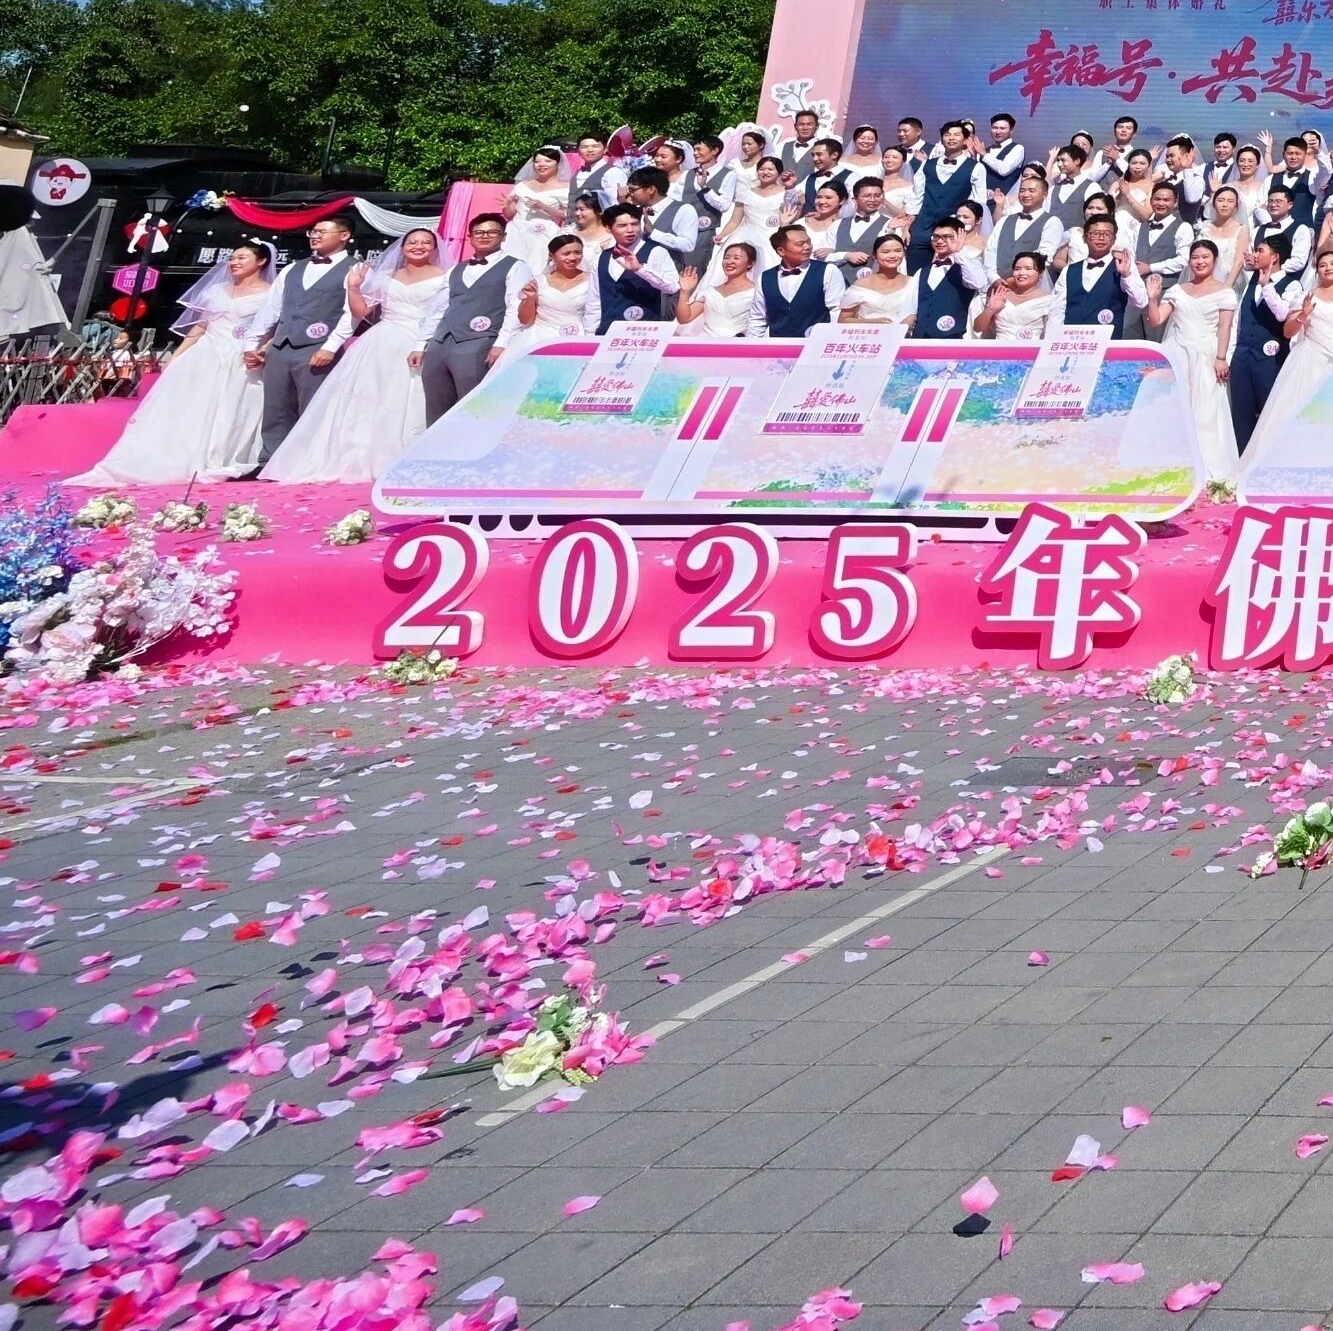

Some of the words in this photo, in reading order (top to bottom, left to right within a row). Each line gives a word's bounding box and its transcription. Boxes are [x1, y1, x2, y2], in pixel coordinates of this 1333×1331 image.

[610, 338, 659, 347] 百年火车站
[1050, 342, 1099, 351] 百年火车站
[823, 342, 882, 354] 百年火车站
